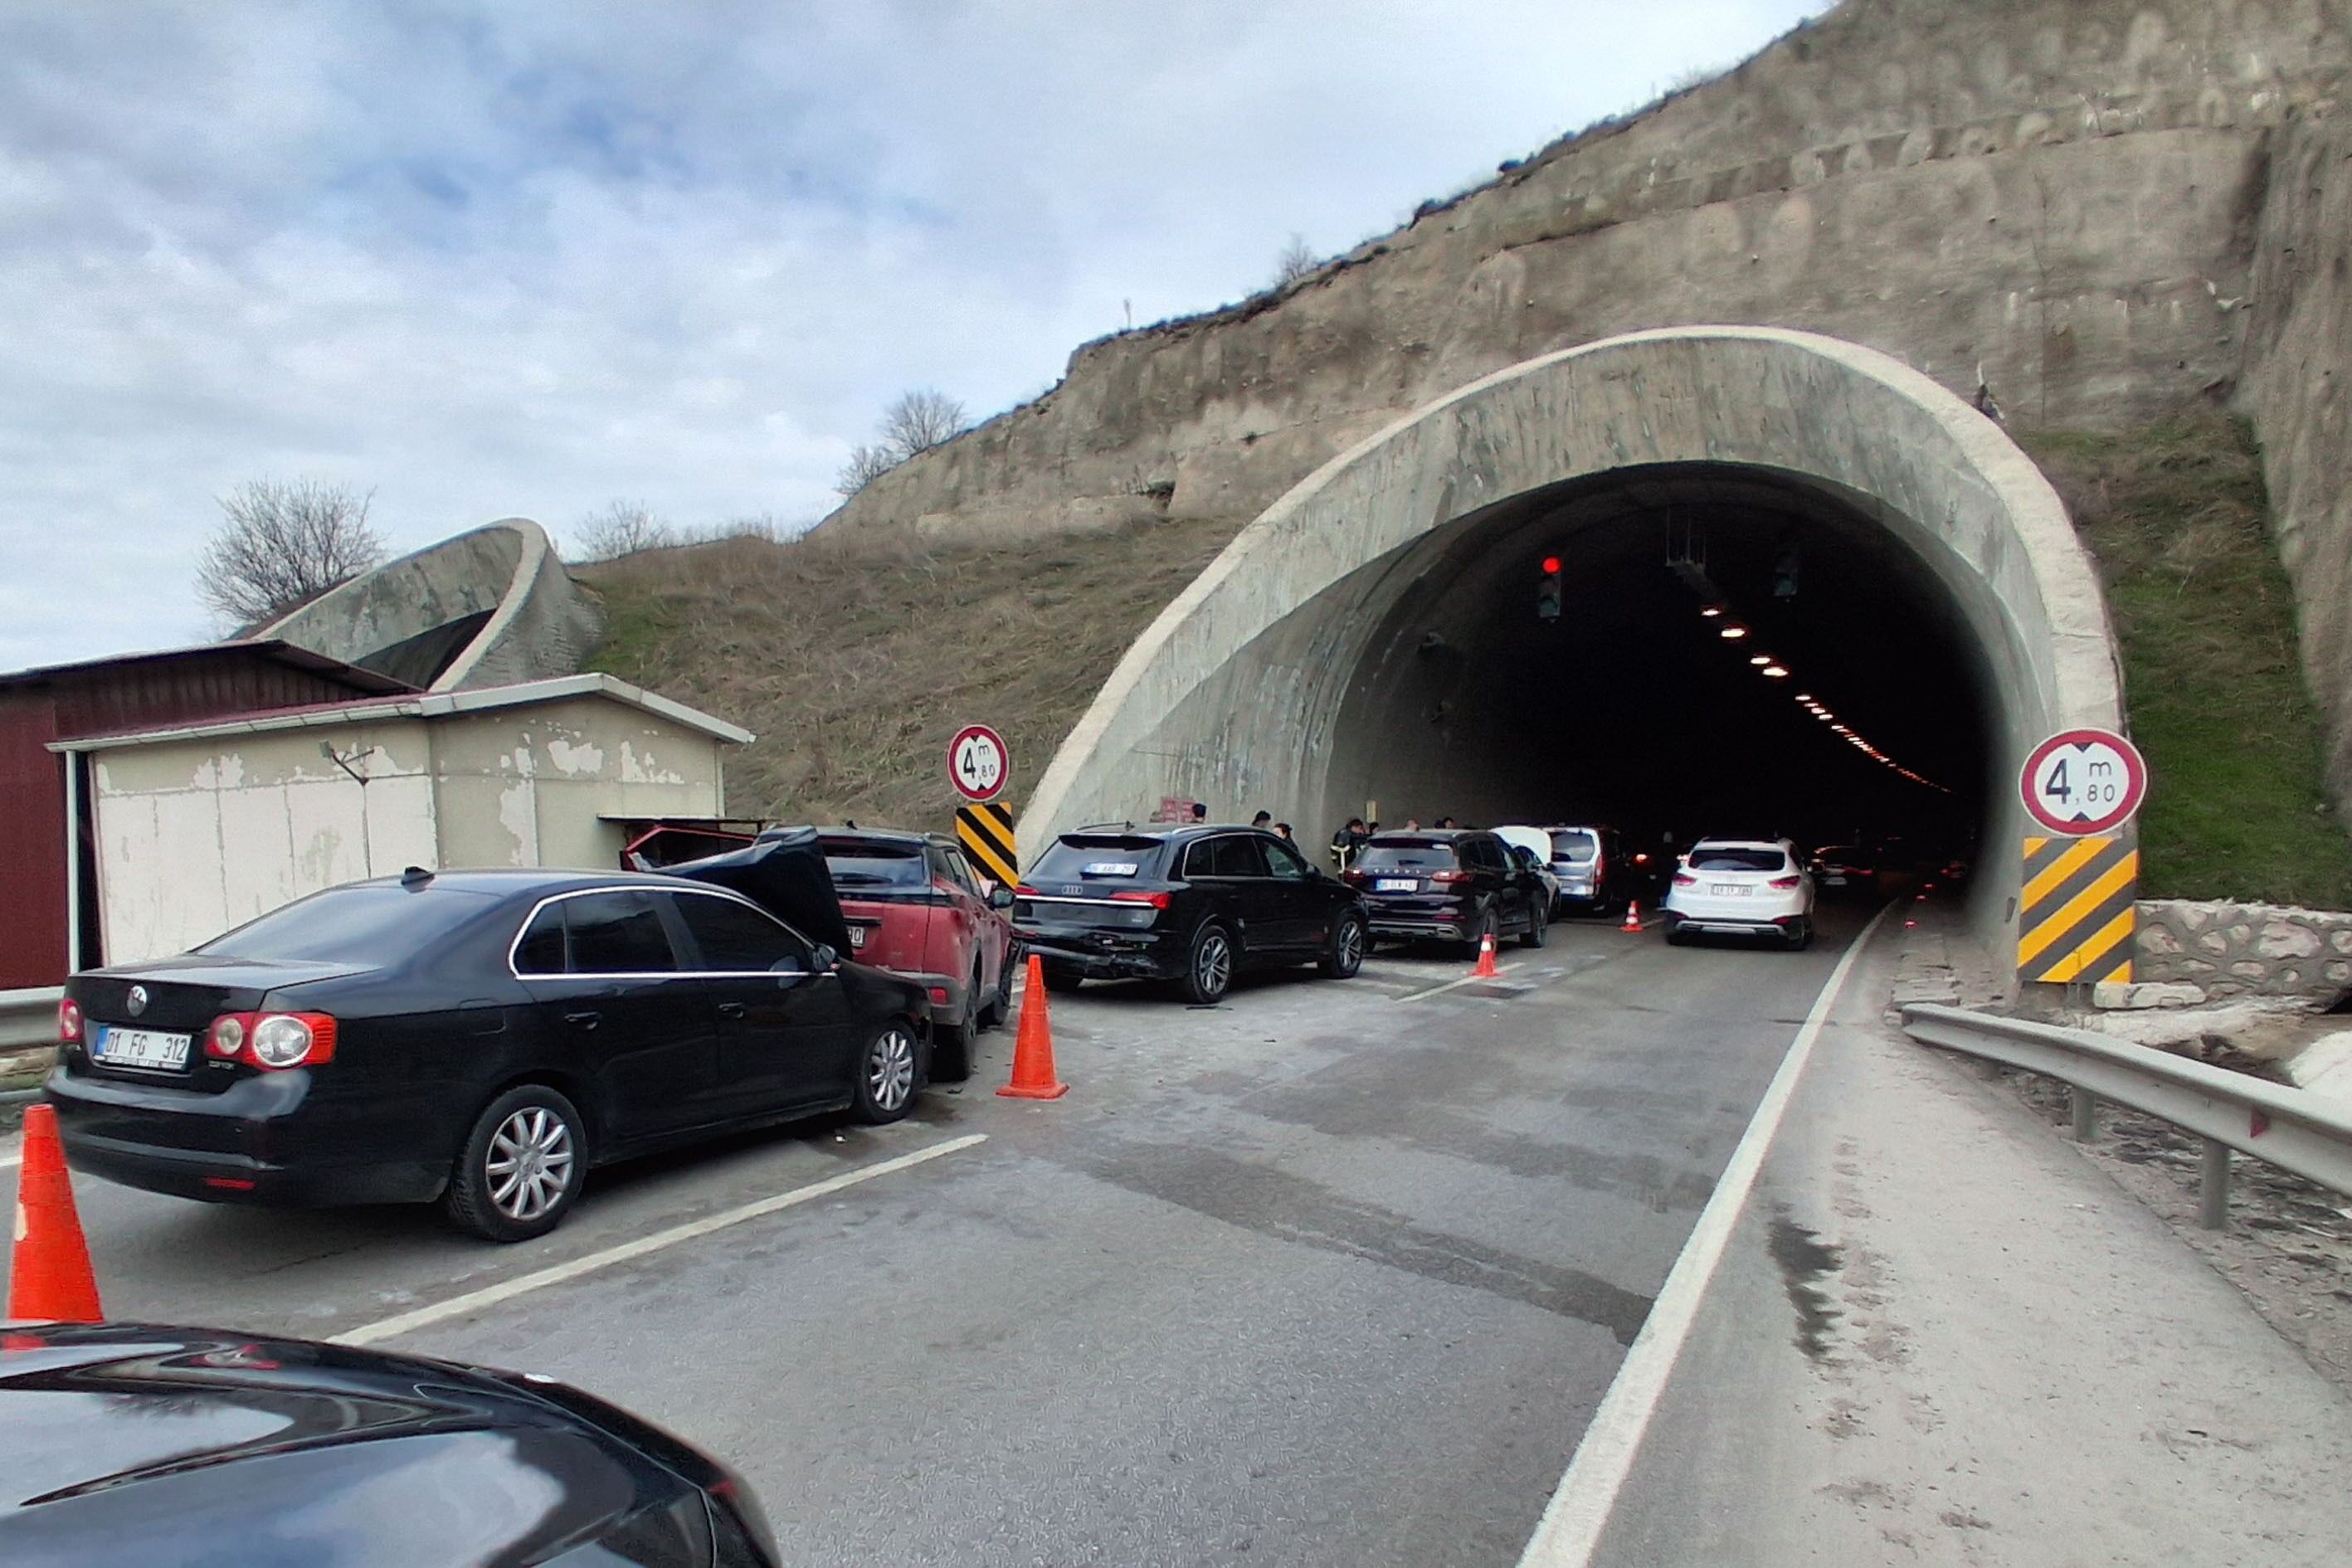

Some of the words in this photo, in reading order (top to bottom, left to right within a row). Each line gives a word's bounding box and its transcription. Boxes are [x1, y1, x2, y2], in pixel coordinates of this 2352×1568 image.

[978, 744, 991, 757] m
[2045, 758, 2072, 805] 4
[2088, 762, 2112, 777] m
[105, 1032, 121, 1054] 01
[129, 1034, 149, 1056] FG
[162, 1037, 188, 1062] 312
